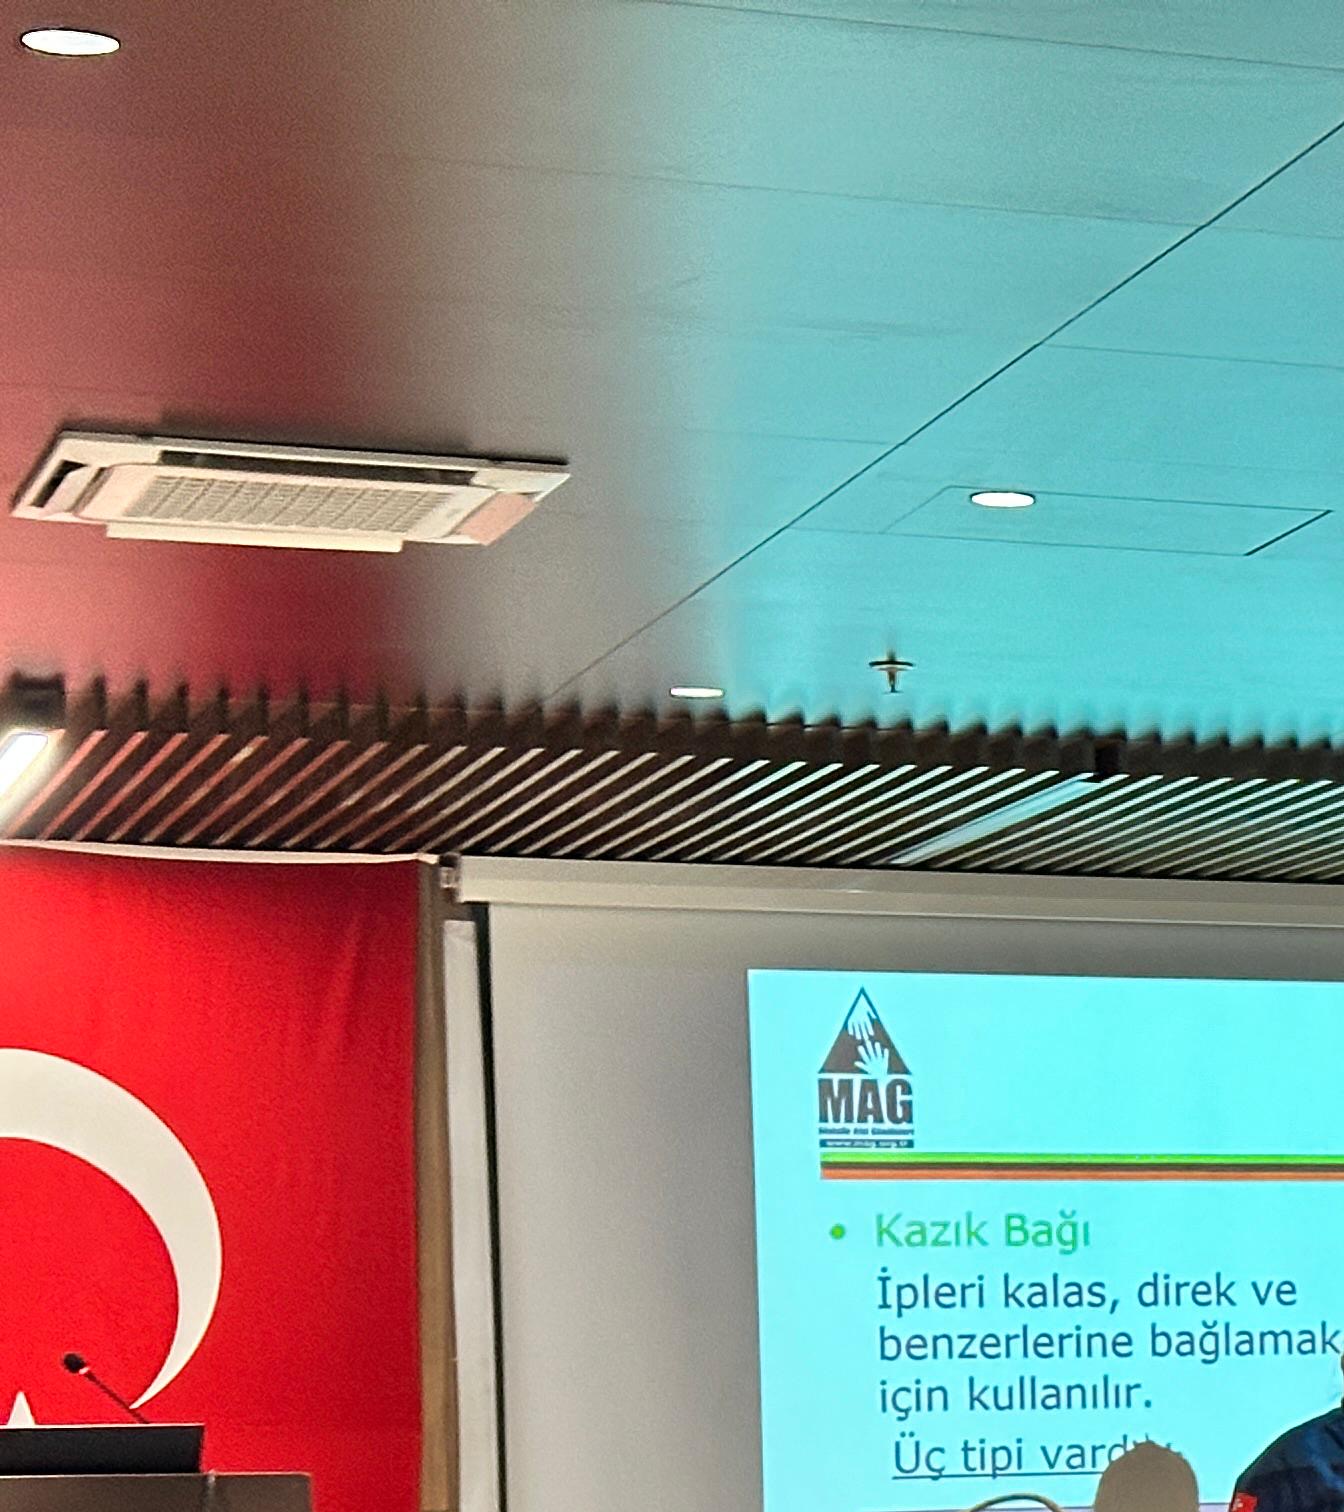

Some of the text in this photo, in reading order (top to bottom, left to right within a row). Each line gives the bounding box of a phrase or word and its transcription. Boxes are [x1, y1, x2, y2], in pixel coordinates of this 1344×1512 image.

[818, 1078, 913, 1124] MAG
[876, 1209, 1092, 1256] Kazık Bağı
[877, 1266, 1297, 1318] İpleri kalas, direk ve
[880, 1320, 1341, 1366] benzerlerine bağlamak
[880, 1373, 1152, 1418] için kullanılır.
[894, 1431, 946, 1480] Üç
[961, 1437, 1024, 1479] tipi
